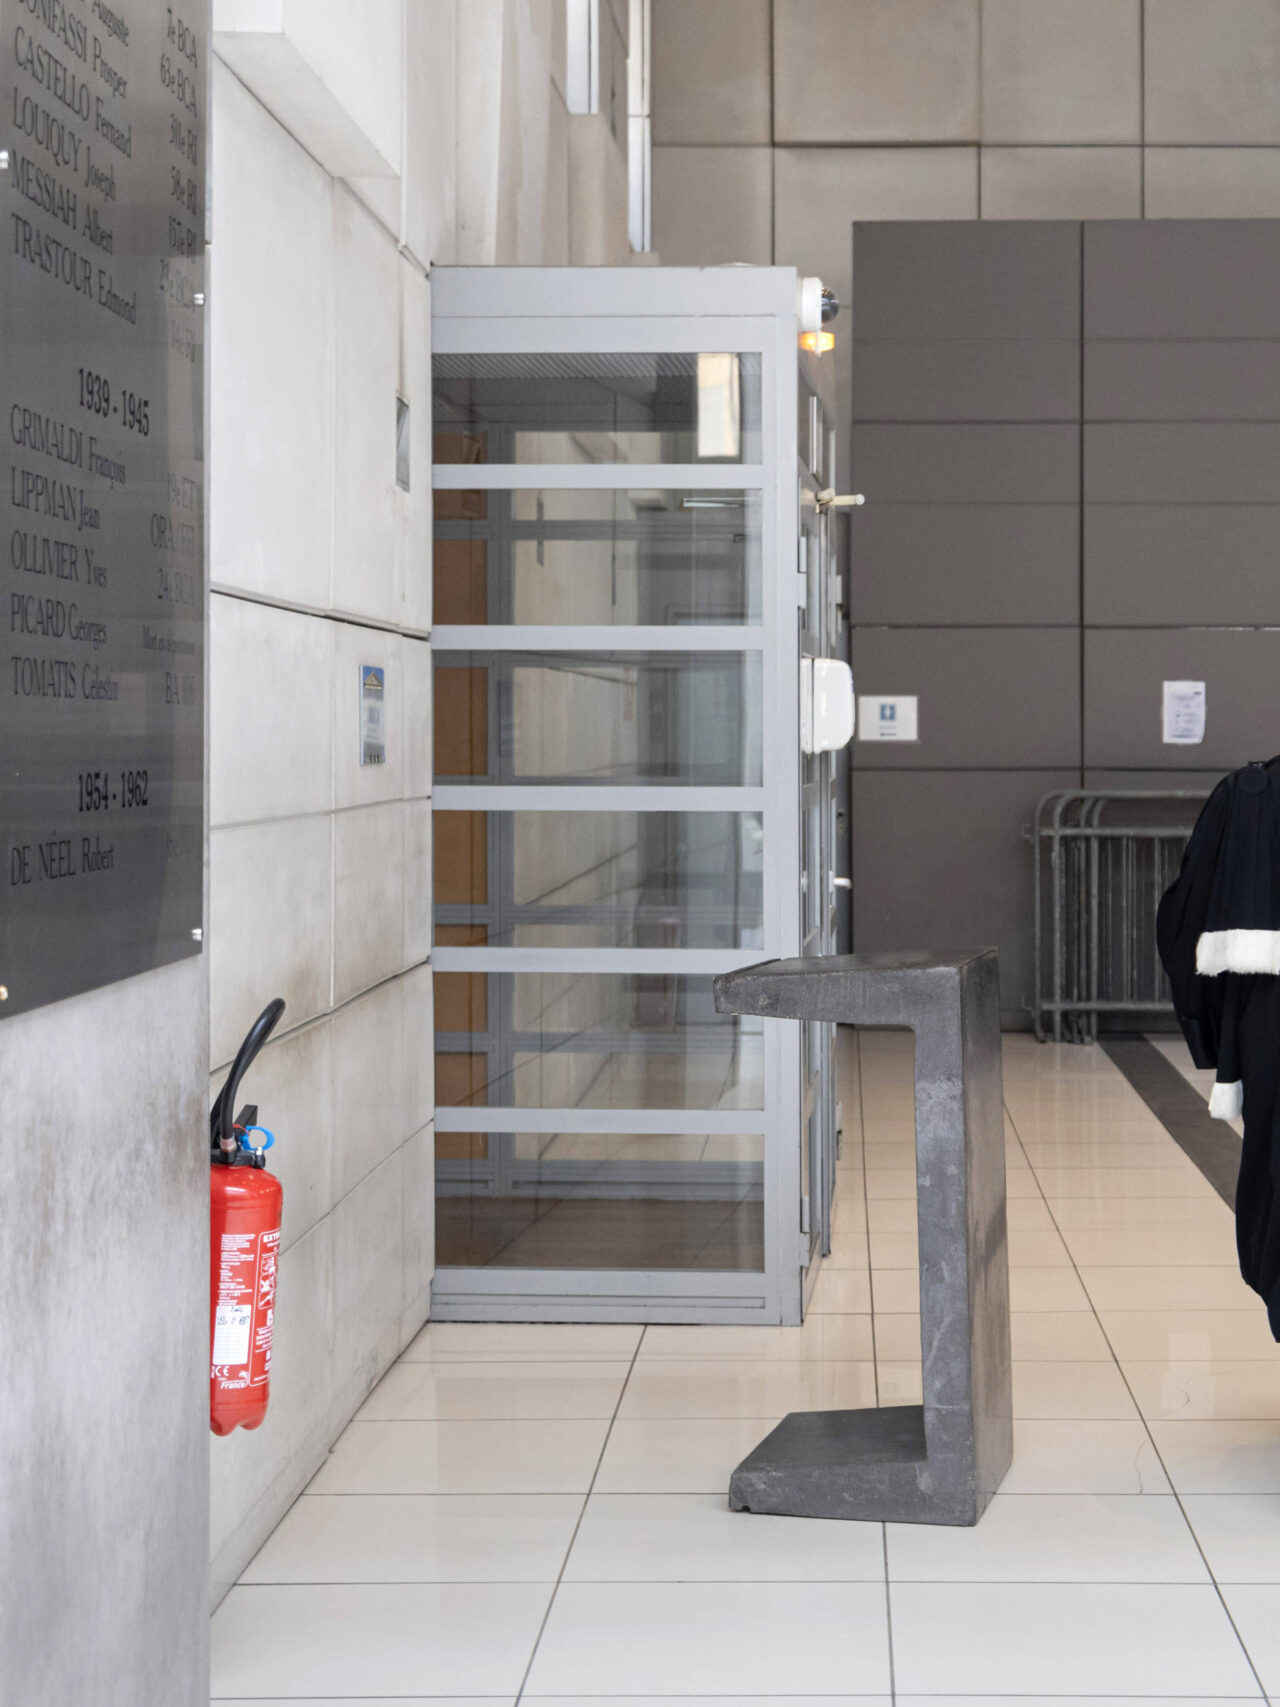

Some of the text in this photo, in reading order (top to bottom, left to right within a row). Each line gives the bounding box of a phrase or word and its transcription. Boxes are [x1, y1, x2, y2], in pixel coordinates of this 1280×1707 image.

[92, 36, 127, 99] Prosper
[177, 18, 197, 69] BCA
[14, 26, 131, 158] CASTELLO Fernand
[177, 68, 197, 119] BCA
[13, 86, 116, 202] LOUIQUY Joseph
[11, 149, 113, 256] MESSIAH Albert
[11, 212, 136, 326] TRASTOUR Edmond
[78, 367, 110, 419] 1939
[121, 390, 150, 437] 1945
[10, 403, 126, 490] GRIMALDI François
[11, 466, 100, 532] LIPPMAN Jean
[11, 529, 107, 588] OLLIVIER Yves
[11, 592, 108, 650] PICARD Georges
[11, 656, 76, 699] TOMATIS
[78, 772, 109, 812] 1954
[121, 770, 149, 809] 1962
[11, 845, 31, 887] DE
[82, 836, 115, 873] Robert
